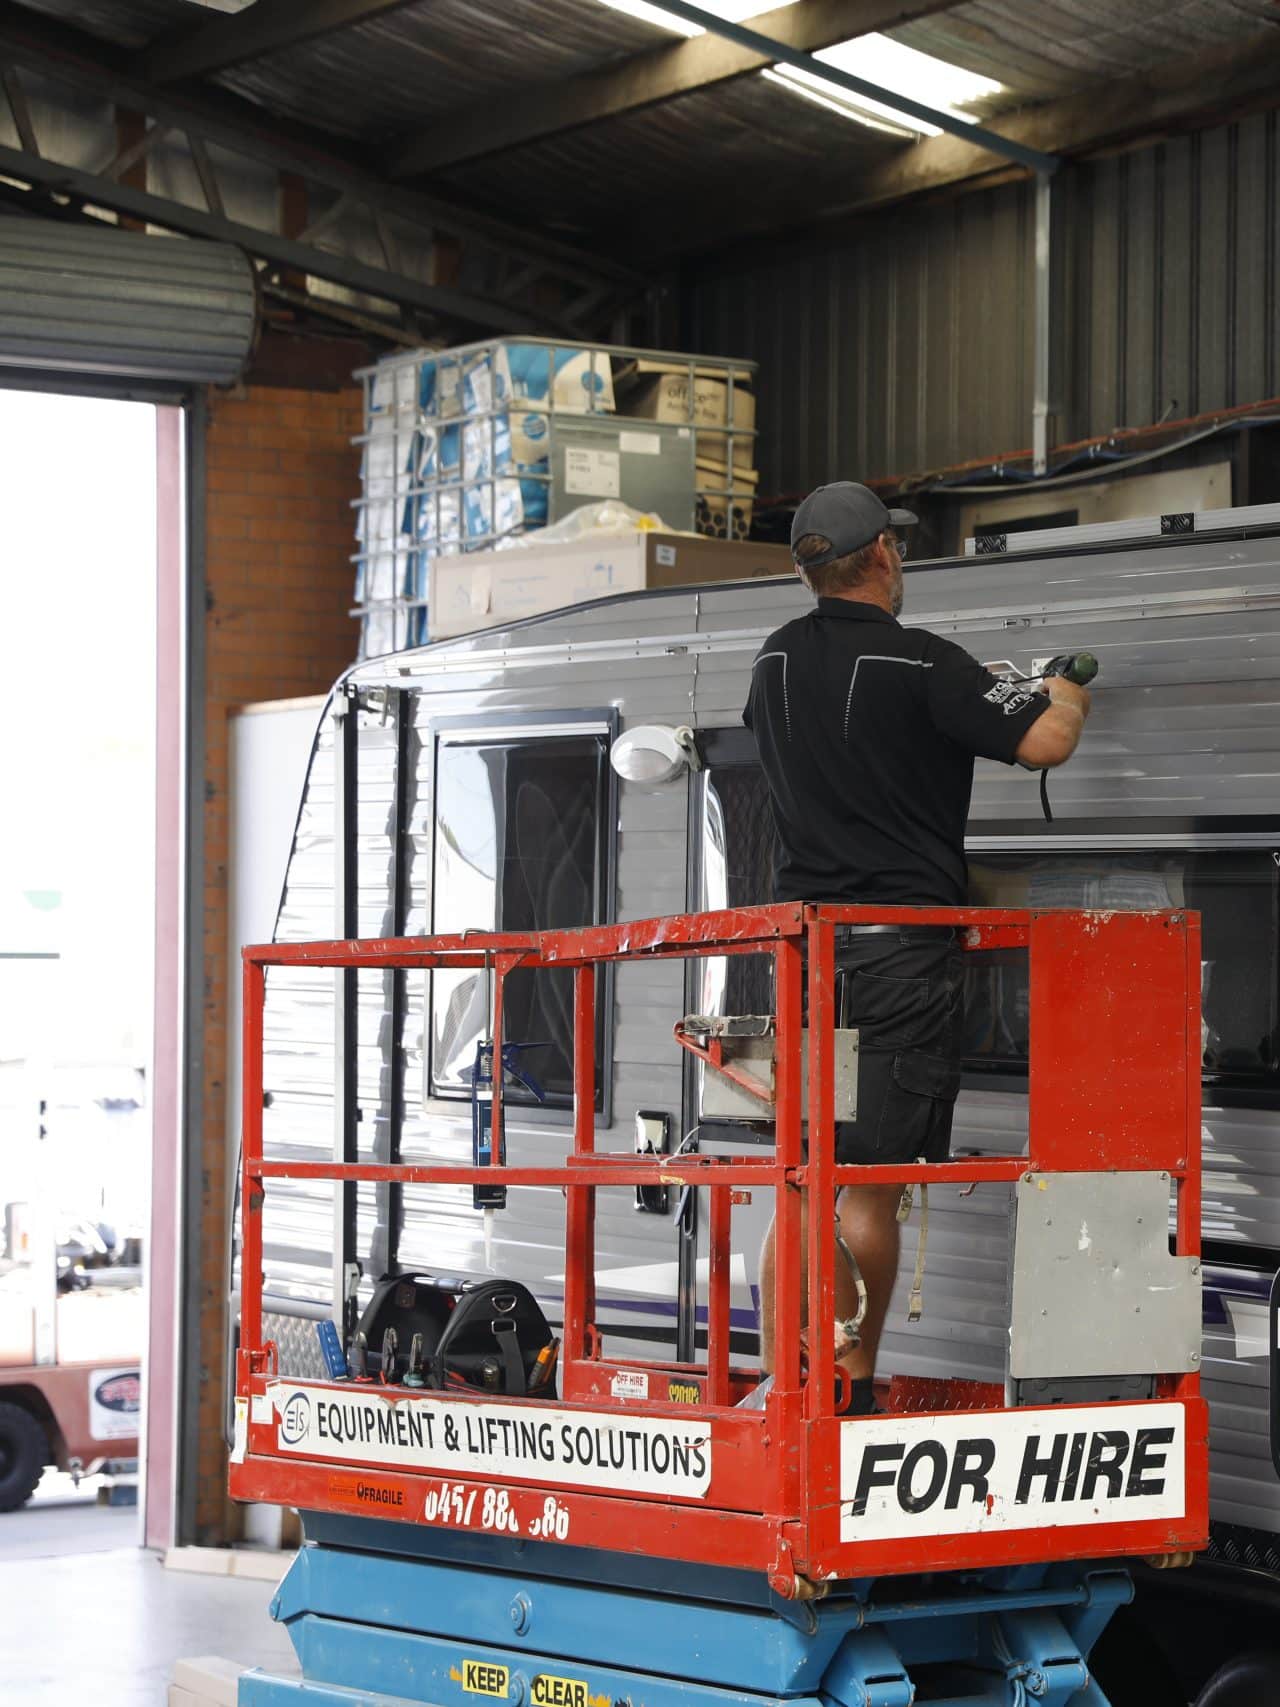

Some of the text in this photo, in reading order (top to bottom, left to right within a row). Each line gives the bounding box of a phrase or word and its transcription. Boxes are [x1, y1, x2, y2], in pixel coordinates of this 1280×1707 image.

[630, 1375, 644, 1387] HIRE
[317, 1402, 706, 1478] EQUIPMENT & LIFTING SOLUTIONS
[852, 1427, 1176, 1516] FOR HIRE
[364, 1487, 403, 1505] FRAGILE
[466, 1664, 586, 1707] KEEP CLEAR
